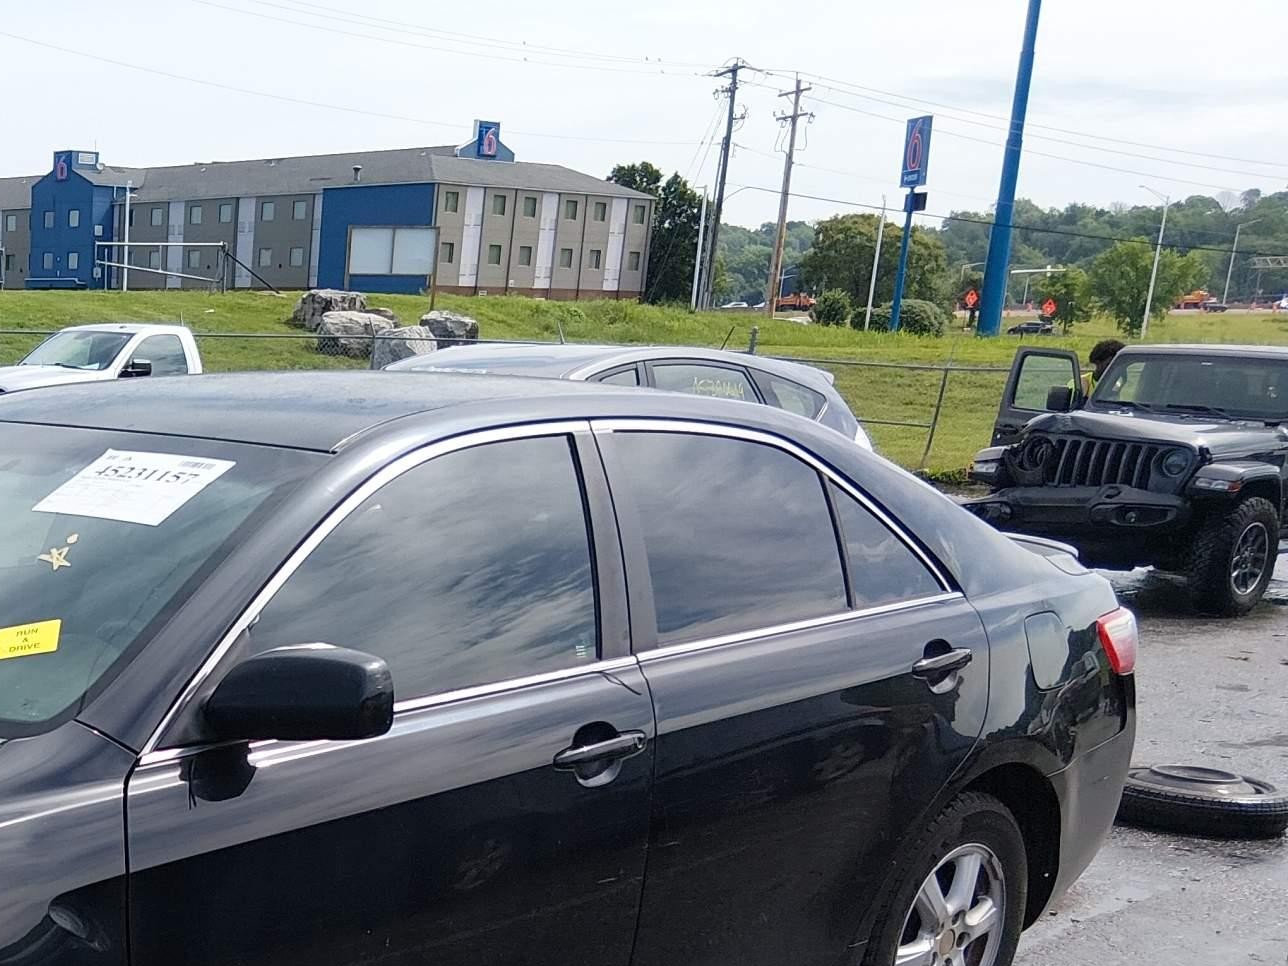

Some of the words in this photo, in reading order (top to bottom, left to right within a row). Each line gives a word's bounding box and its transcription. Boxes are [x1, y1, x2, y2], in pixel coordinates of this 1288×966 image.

[483, 127, 497, 154] 6
[906, 118, 923, 171] 6
[53, 155, 67, 181] 6
[95, 465, 201, 485] 45231157
[16, 628, 38, 637] RUN
[9, 642, 41, 652] DRIVE
